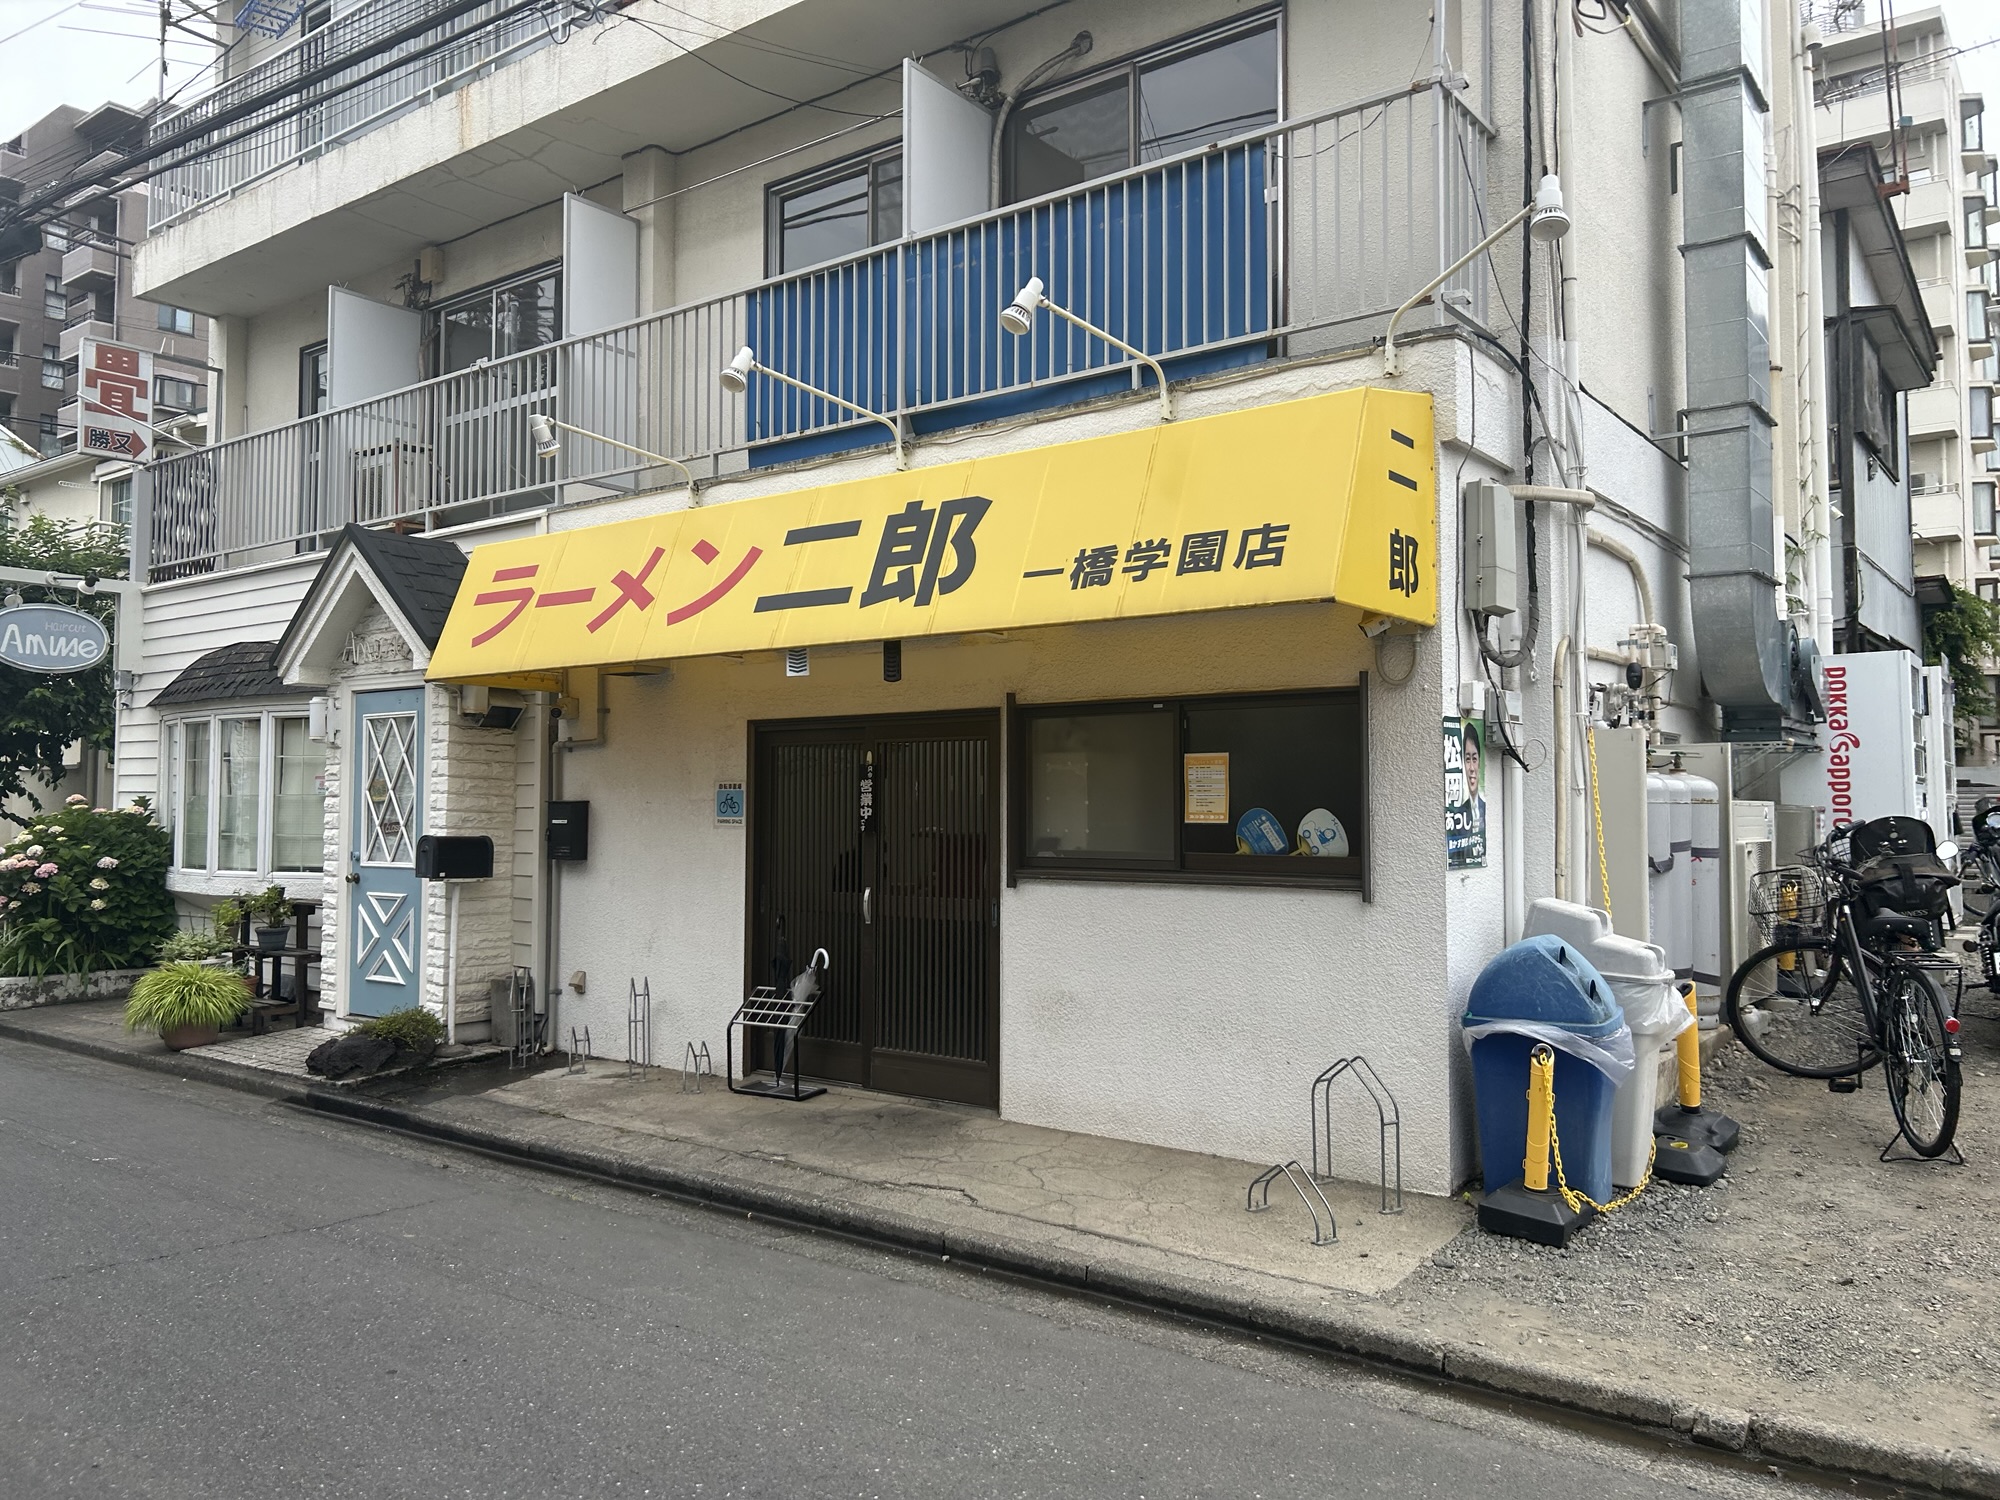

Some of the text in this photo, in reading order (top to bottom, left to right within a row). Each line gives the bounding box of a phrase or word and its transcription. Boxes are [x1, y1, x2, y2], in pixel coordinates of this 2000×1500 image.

[85, 343, 148, 422] 畳
[88, 428, 134, 455] 勝又
[1388, 429, 1419, 598] 二郎
[471, 496, 1290, 648] ラーメン二郎 一橋学園店
[0, 623, 98, 658] Amuse
[45, 621, 87, 633] Haircut
[1443, 733, 1462, 808] 松岡
[1445, 811, 1472, 830] あつし
